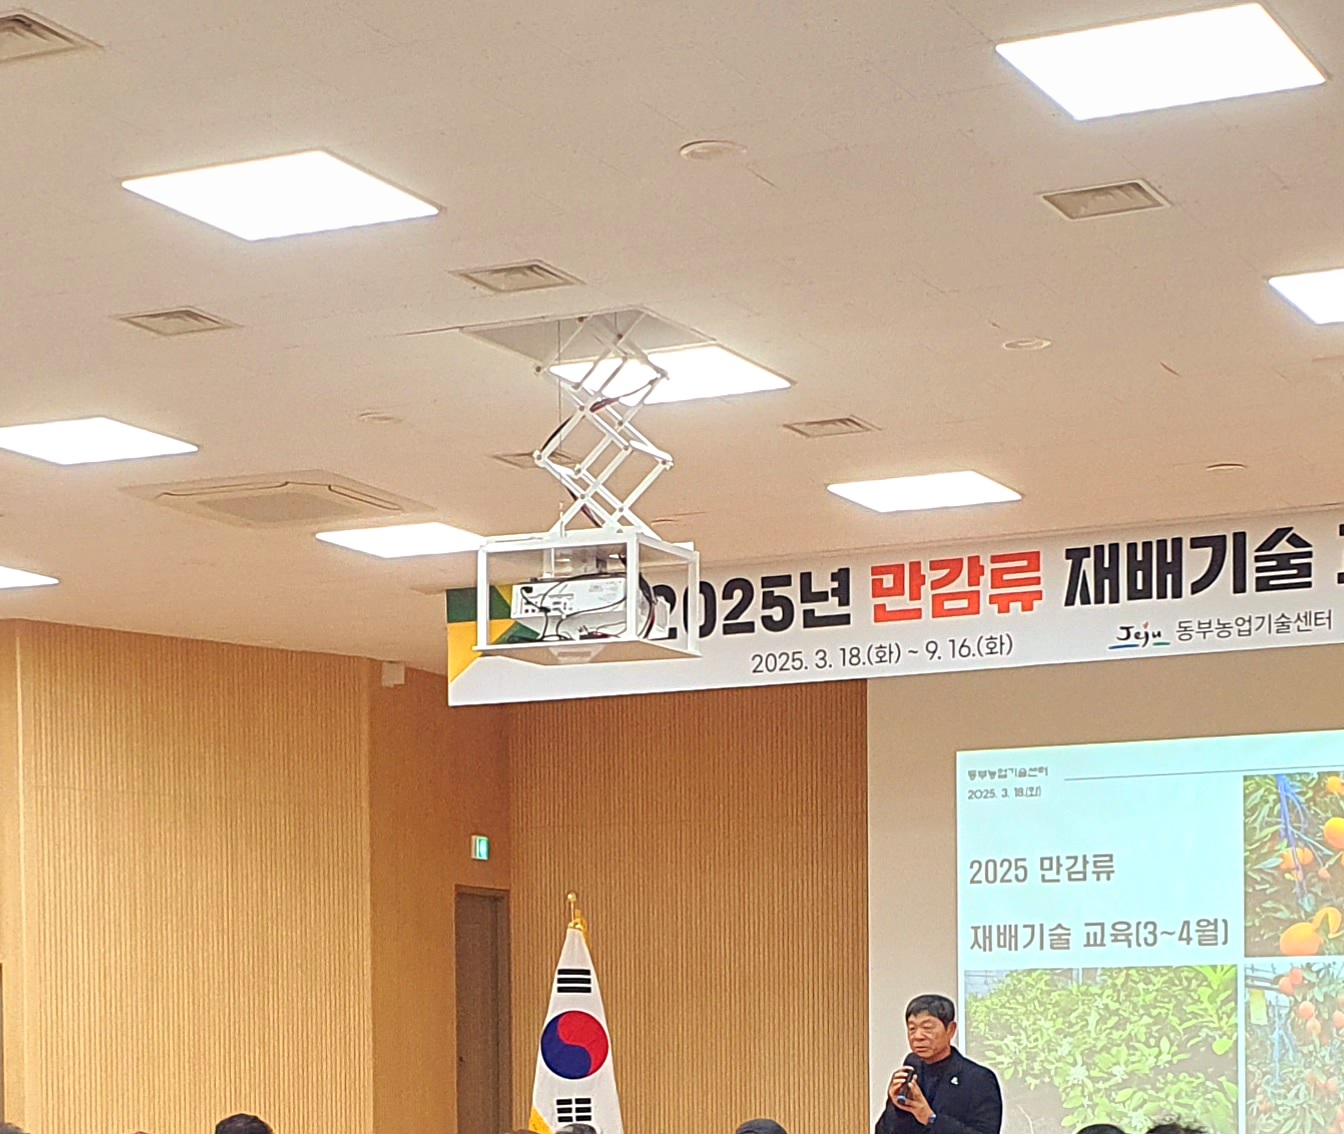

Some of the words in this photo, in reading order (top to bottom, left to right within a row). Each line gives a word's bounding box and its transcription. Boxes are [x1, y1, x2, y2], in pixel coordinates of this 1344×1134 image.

[870, 550, 1044, 624] 만감류
[1063, 526, 1314, 607] 재배기술
[1116, 623, 1162, 648] Jeju
[1175, 609, 1333, 642] 동부농업기술센터
[751, 651, 808, 674] 2025.
[814, 649, 833, 669] 3.
[839, 642, 902, 667] 18.(화)
[925, 639, 942, 661] 9.
[948, 633, 1014, 659] 16.(화)
[969, 857, 1028, 884] 2025
[1039, 853, 1116, 883] 만감류
[969, 922, 1072, 952] 재배기술
[1083, 917, 1229, 949] 교육(3~4월)
